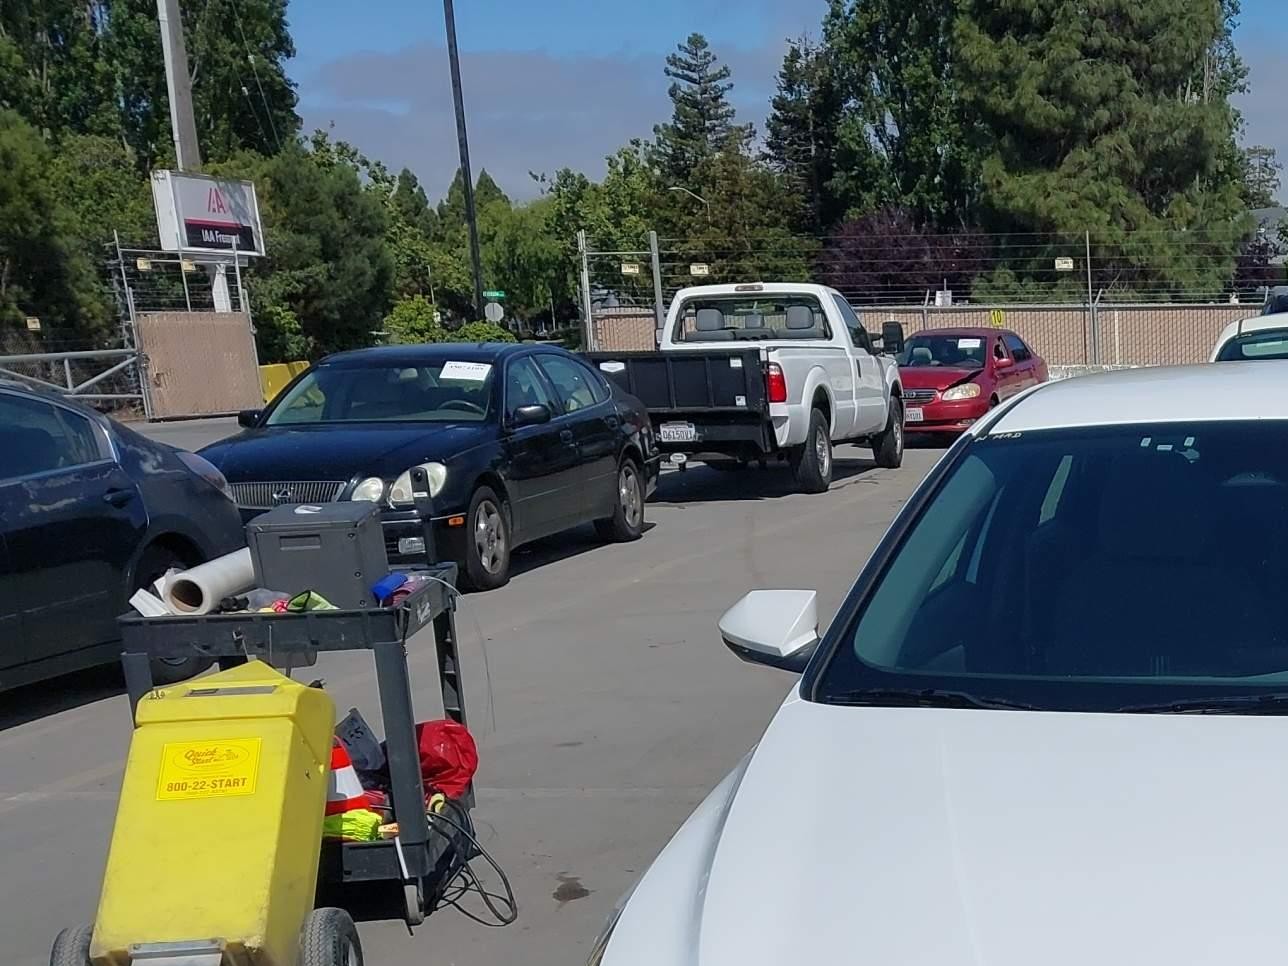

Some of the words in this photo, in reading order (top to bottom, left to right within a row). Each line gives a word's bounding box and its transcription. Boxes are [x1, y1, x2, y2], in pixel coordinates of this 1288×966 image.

[214, 230, 241, 245] Fret
[992, 310, 1002, 324] 10
[184, 747, 218, 760] Quick
[166, 777, 248, 792] 800-22-START
